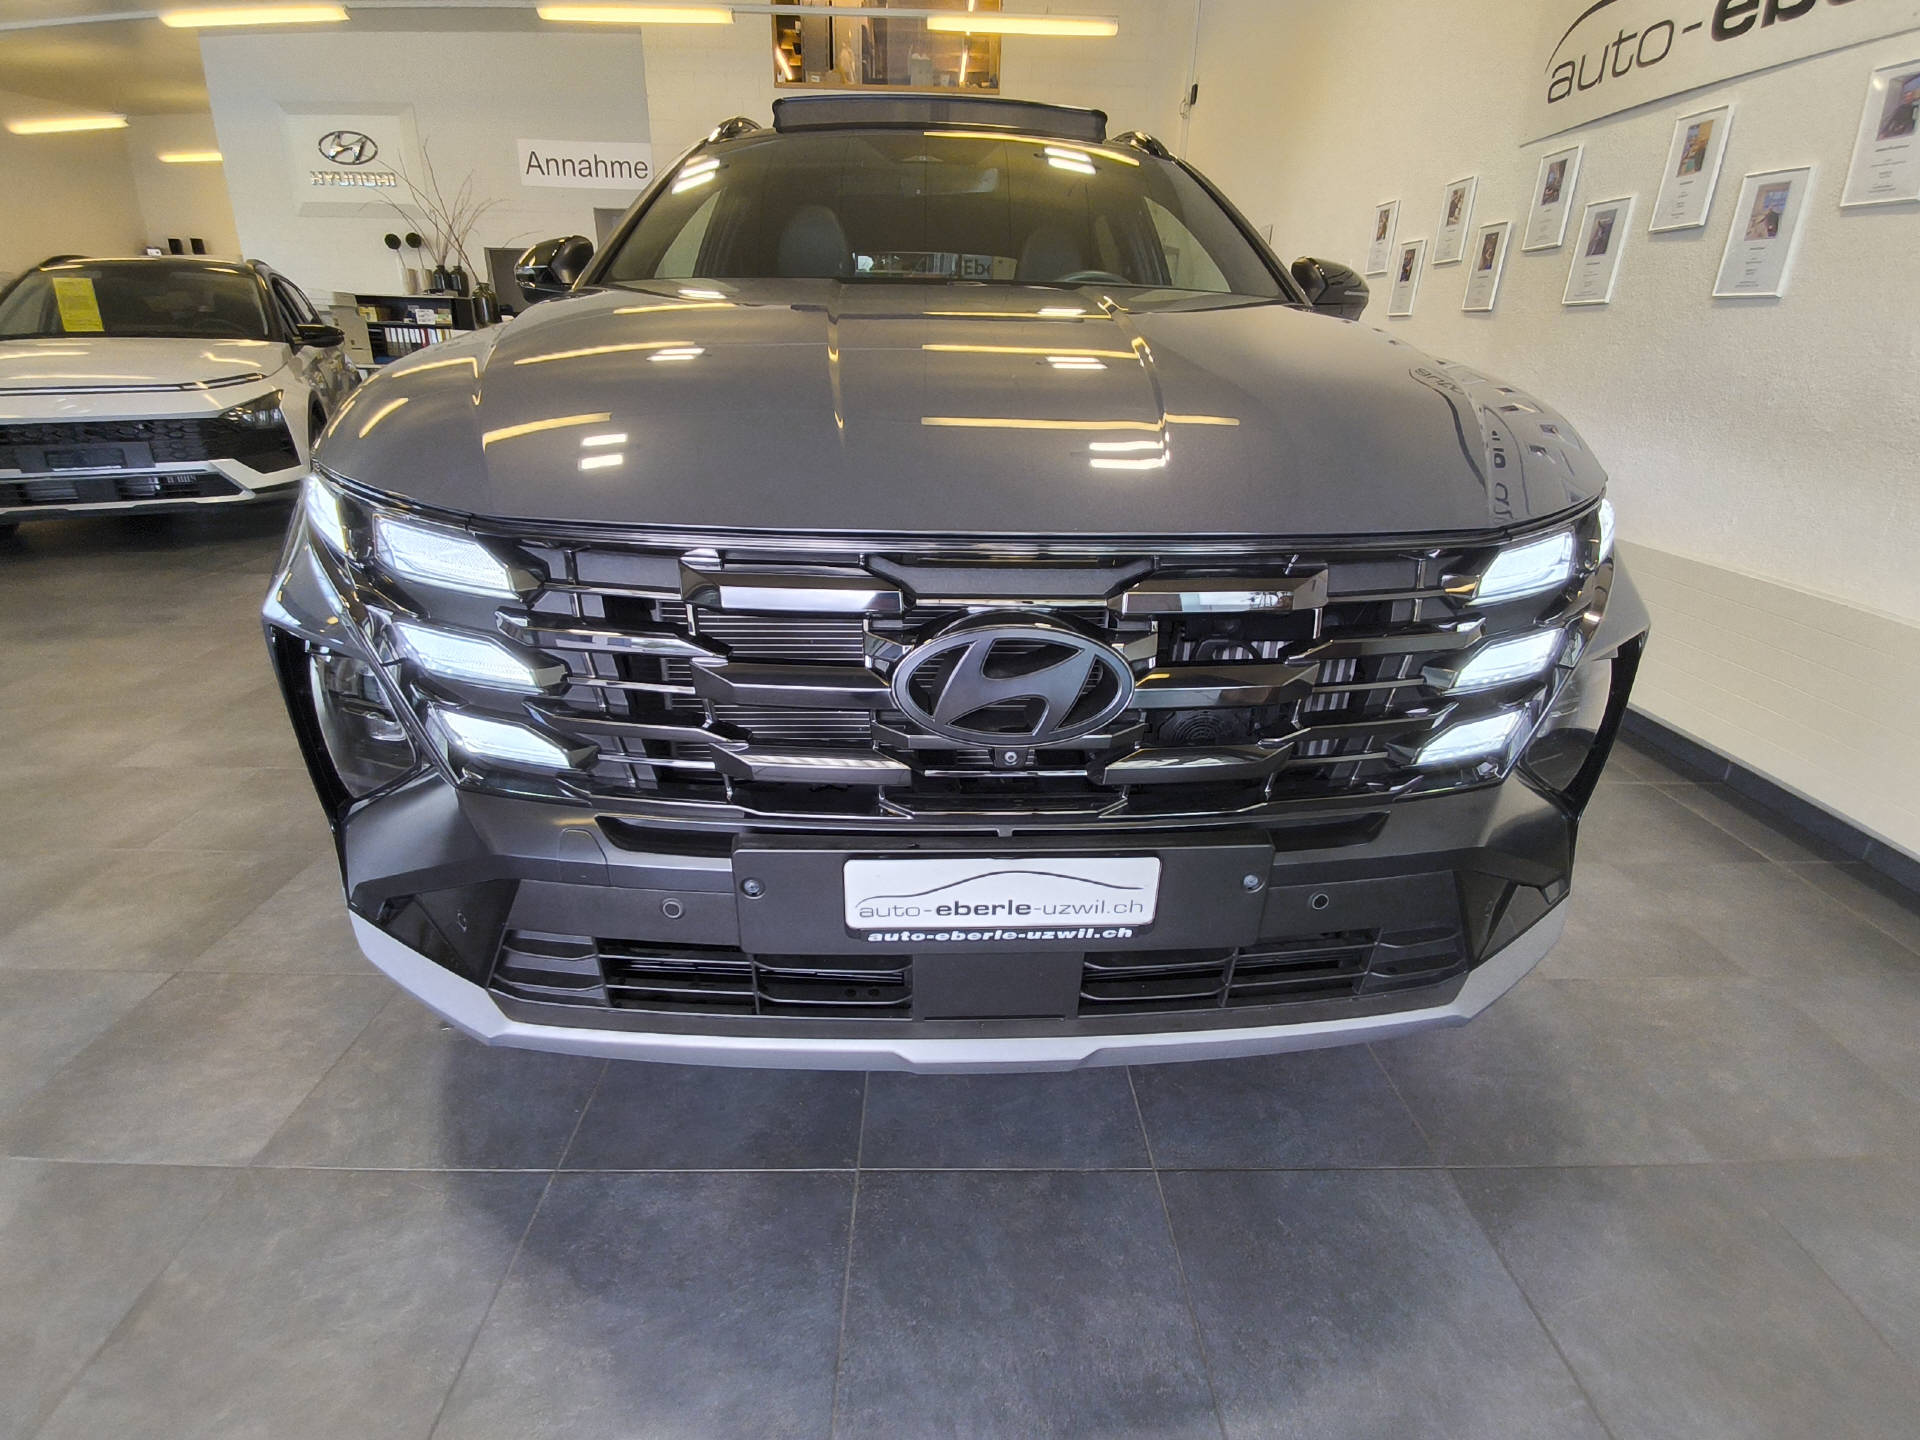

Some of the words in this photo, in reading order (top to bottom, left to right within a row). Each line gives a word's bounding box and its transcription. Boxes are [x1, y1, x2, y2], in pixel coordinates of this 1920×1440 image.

[526, 151, 649, 179] Annahme
[310, 171, 397, 187] HYUNDAI
[859, 900, 1144, 918] auto-eberle-uzwil.ch
[868, 928, 1133, 942] auto-eberle-uzwil.ch
